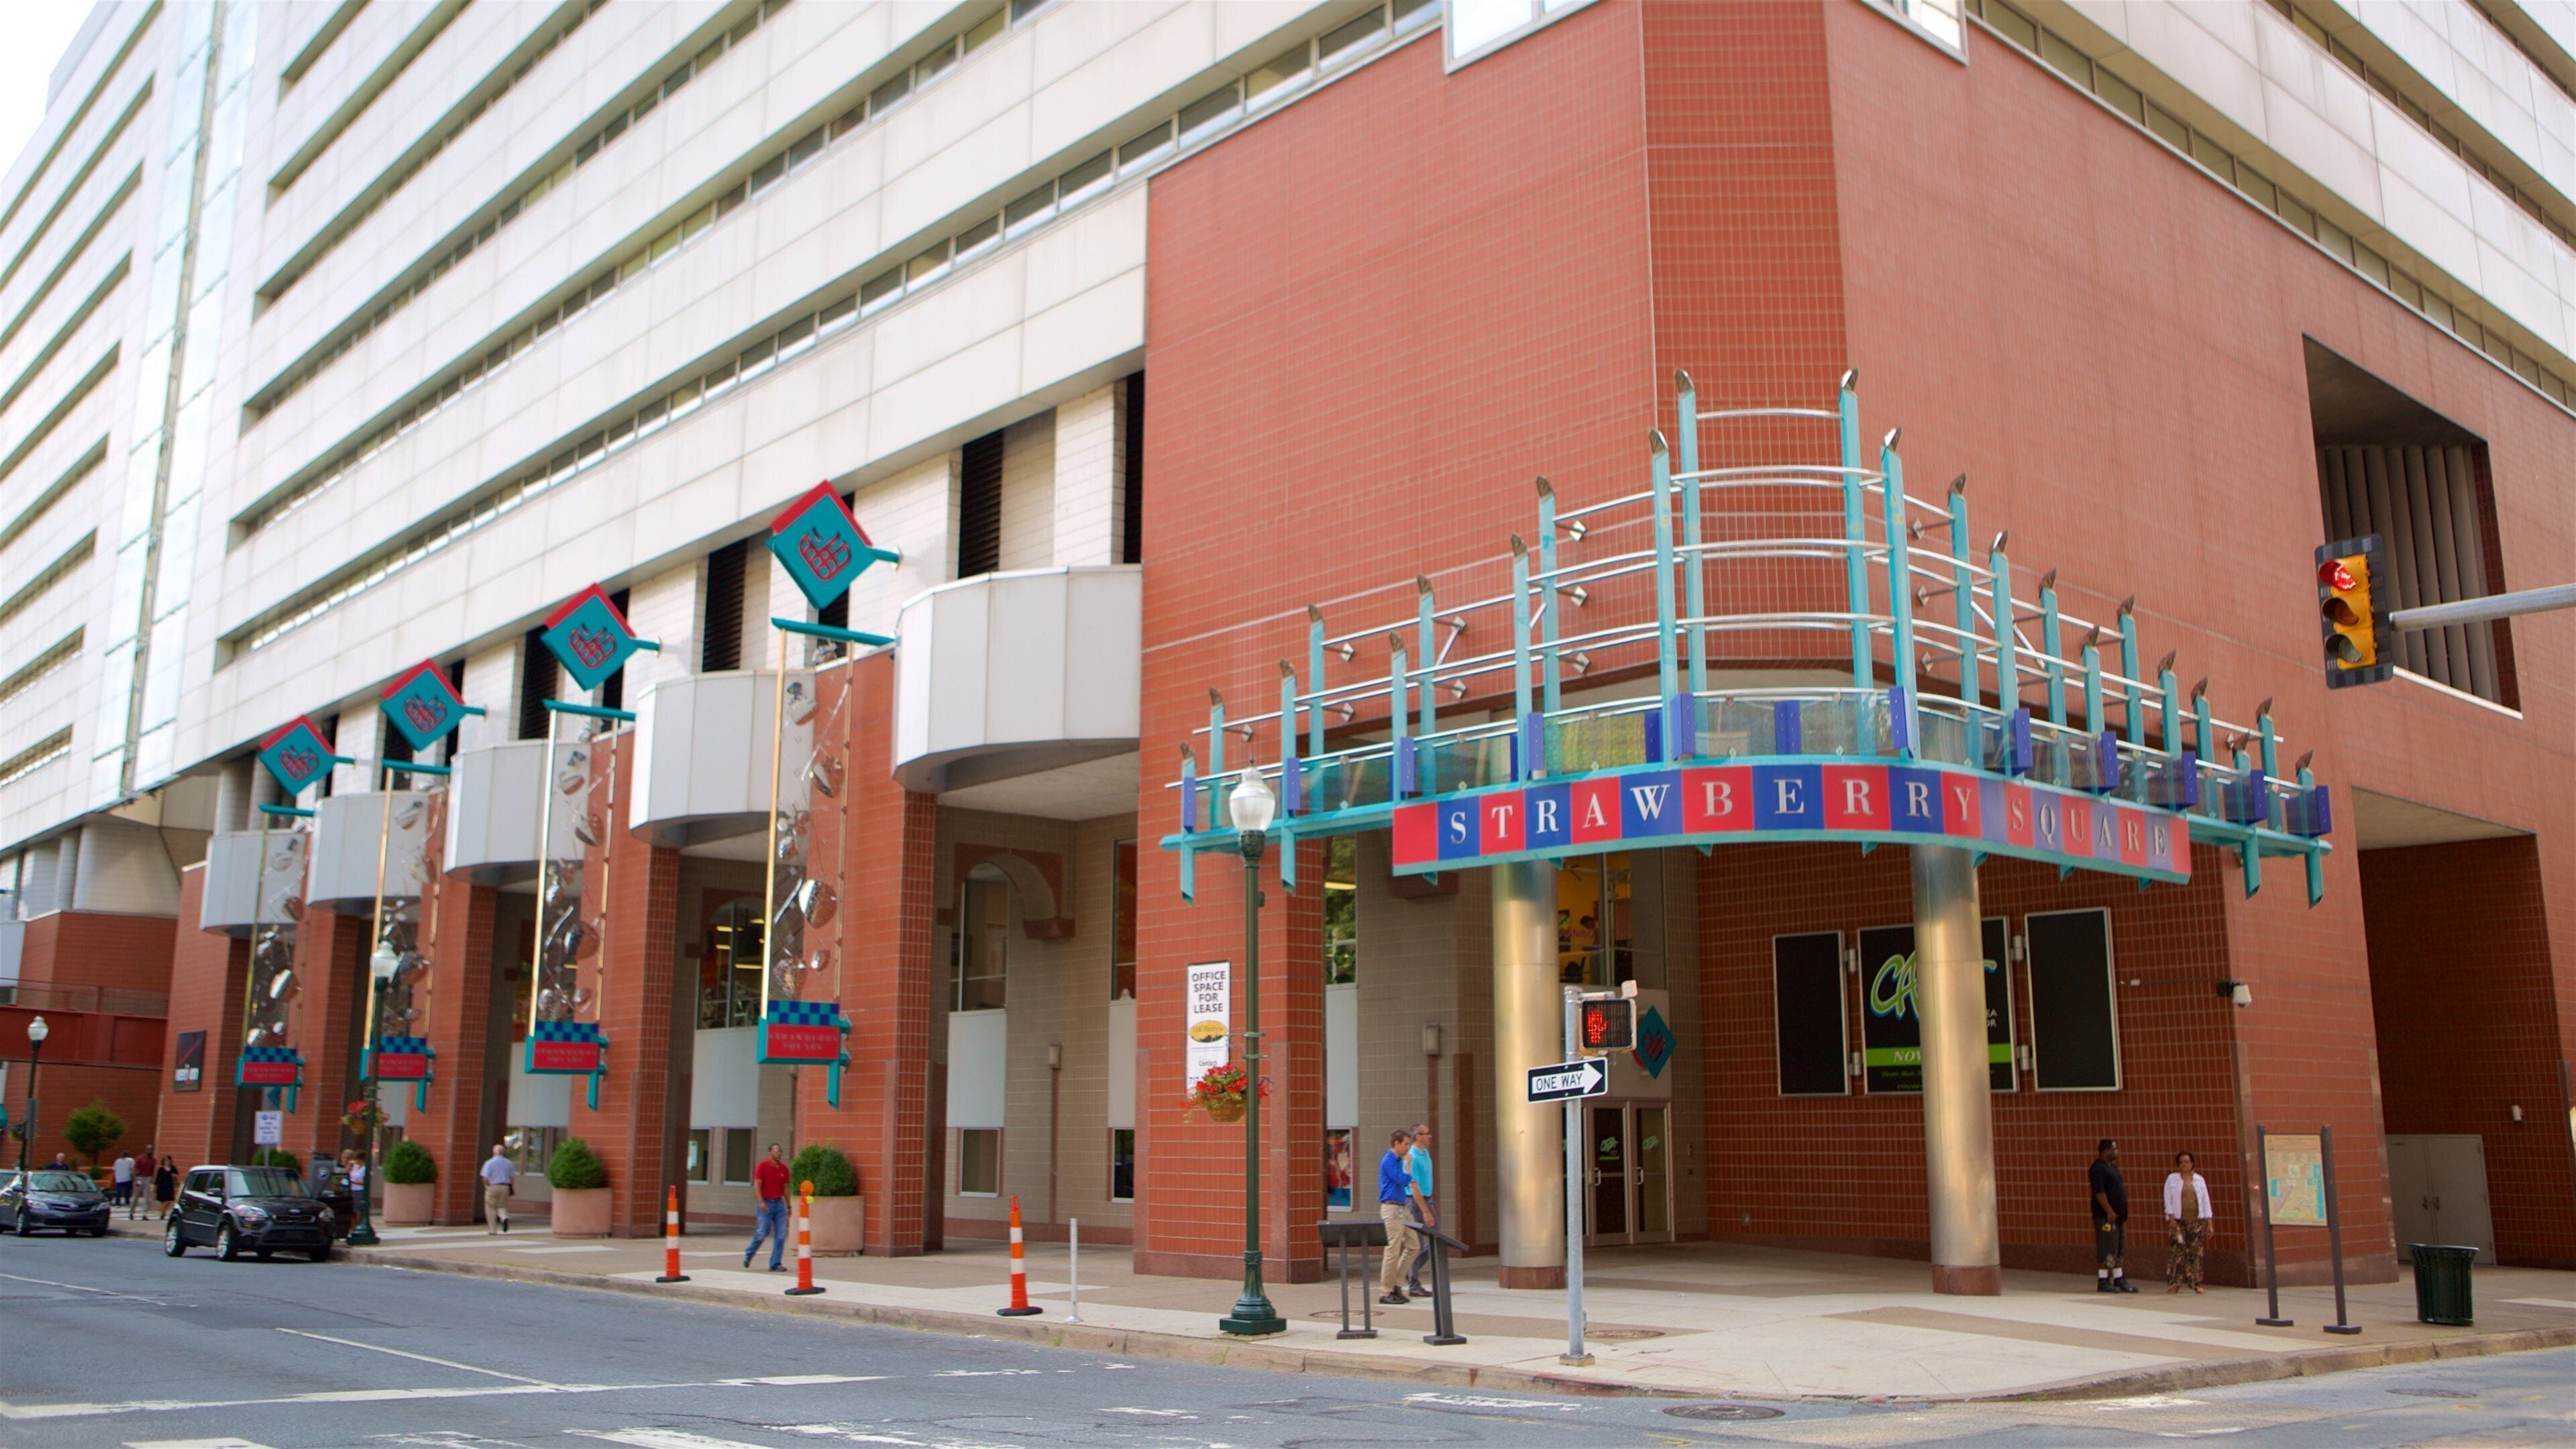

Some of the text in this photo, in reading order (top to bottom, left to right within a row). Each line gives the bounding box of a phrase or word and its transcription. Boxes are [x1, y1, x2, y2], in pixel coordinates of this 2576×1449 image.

[1450, 778, 2167, 857] STRAWBERRY SQUARE
[1192, 971, 1226, 981] OFFICE
[1194, 981, 1224, 992] SPACE
[1199, 993, 1218, 1002] FOR
[1194, 1003, 1224, 1014] LEASE
[1536, 1073, 1583, 1091] ONE WAY
